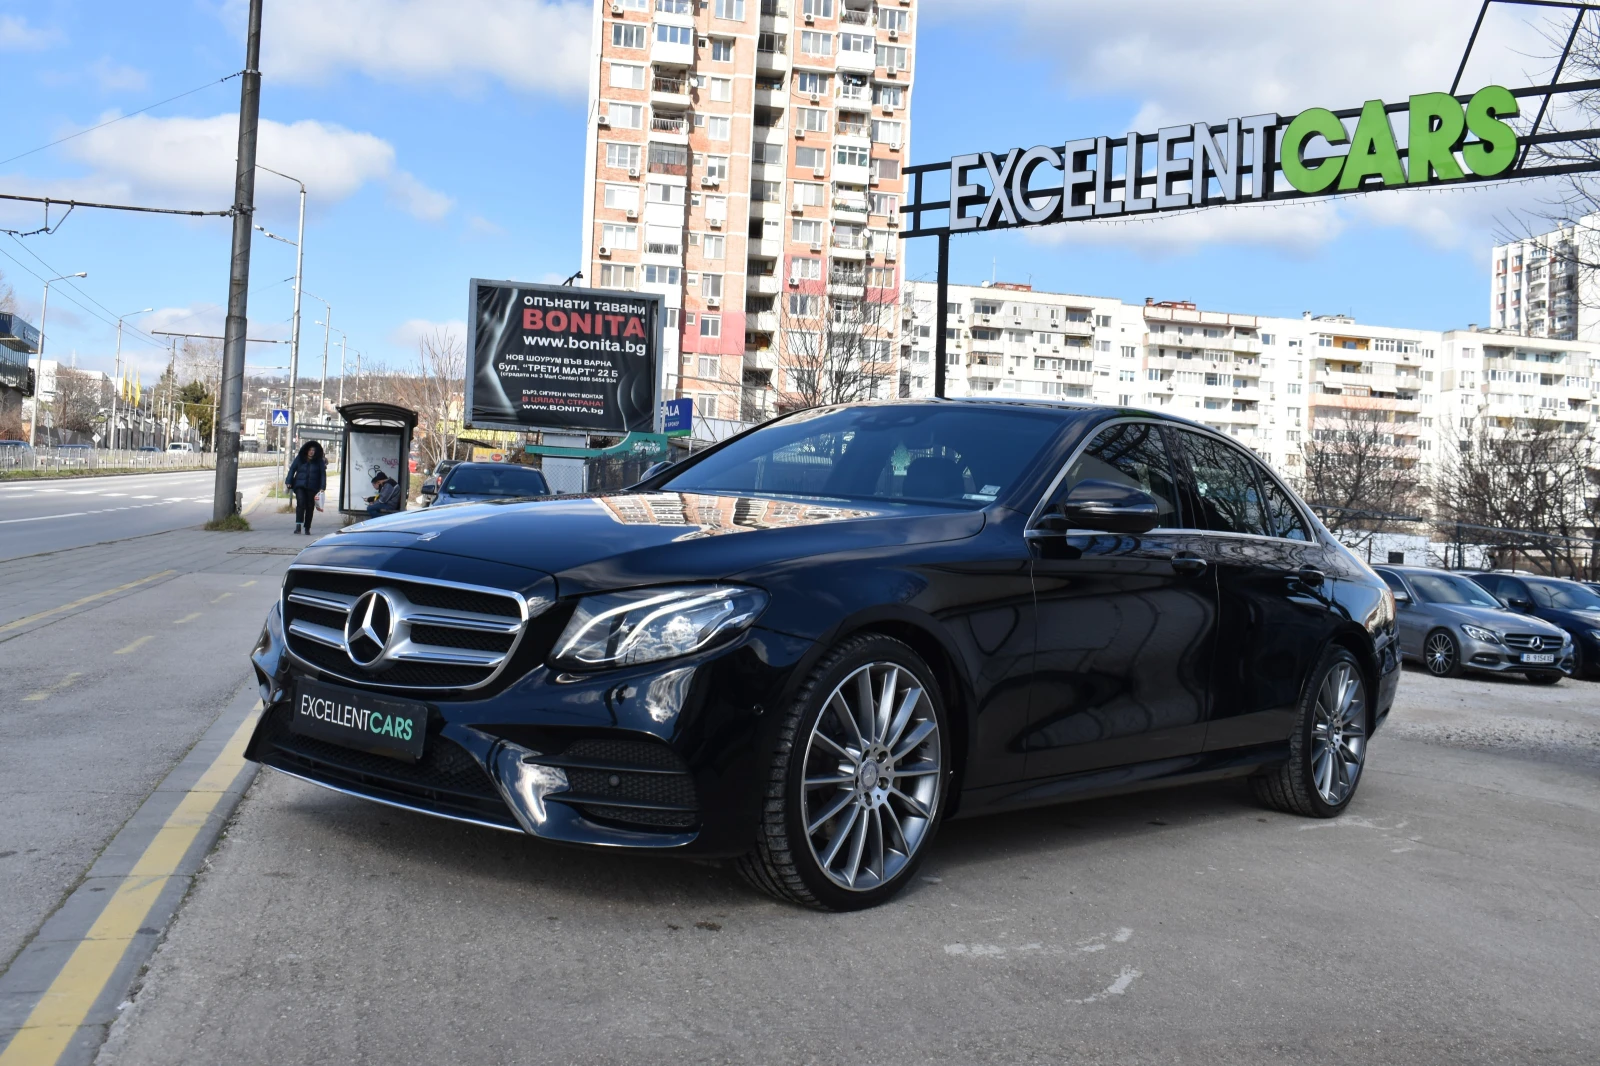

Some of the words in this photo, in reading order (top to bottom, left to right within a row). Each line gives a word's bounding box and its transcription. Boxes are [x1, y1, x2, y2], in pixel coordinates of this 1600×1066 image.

[523, 296, 590, 310] опънати
[594, 301, 646, 315] тавани
[522, 308, 646, 338] BONITA
[523, 335, 647, 356] www.bonita.bg
[506, 353, 524, 361] НОВ
[526, 355, 562, 365] ШОУРУМ
[584, 359, 613, 368] ВАРНА
[498, 362, 520, 372] бул.
[597, 369, 609, 377] 22
[611, 370, 619, 378] Б
[522, 404, 604, 415] www.BONITA.bg
[530, 396, 565, 404] ЦЯЛАТА
[567, 399, 604, 407] СТРАНА!
